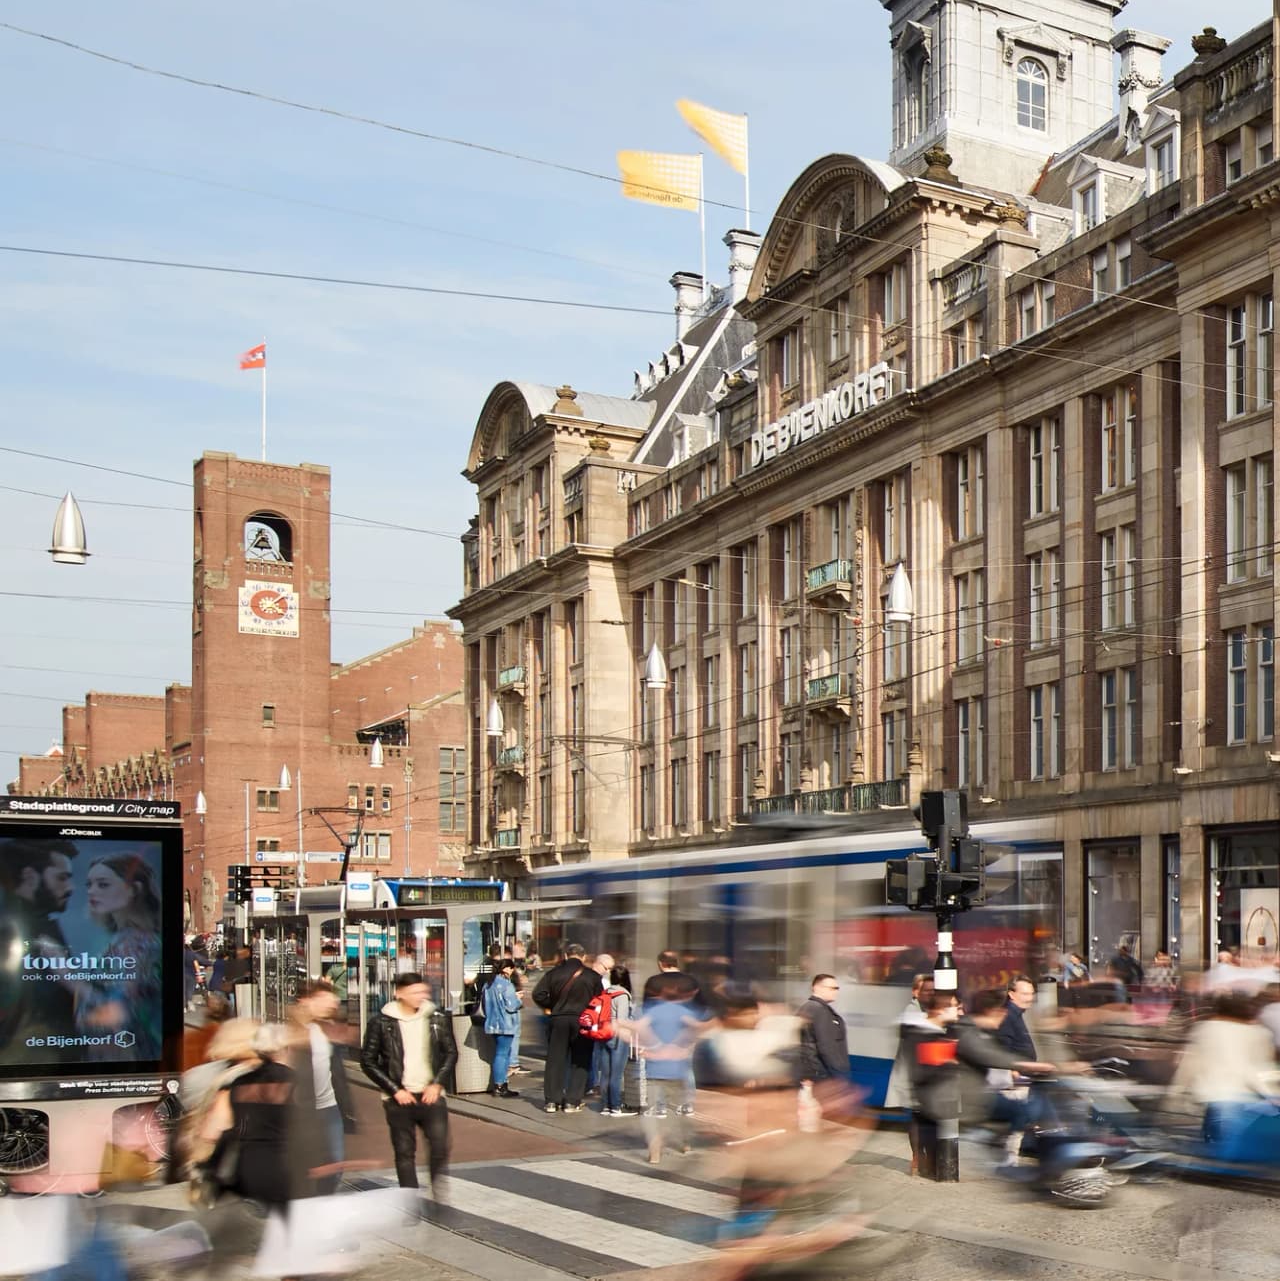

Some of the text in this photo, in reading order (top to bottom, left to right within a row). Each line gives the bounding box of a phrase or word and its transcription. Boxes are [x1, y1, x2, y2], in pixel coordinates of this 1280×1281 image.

[751, 361, 888, 468] DE BIJENKORF
[9, 800, 115, 813] Stadsplattegrond
[125, 804, 146, 815] City
[149, 806, 175, 816] map
[59, 828, 102, 837] JCDecaux
[408, 889, 415, 900] 4
[22, 972, 137, 982] ook op deBijenkorf.nl
